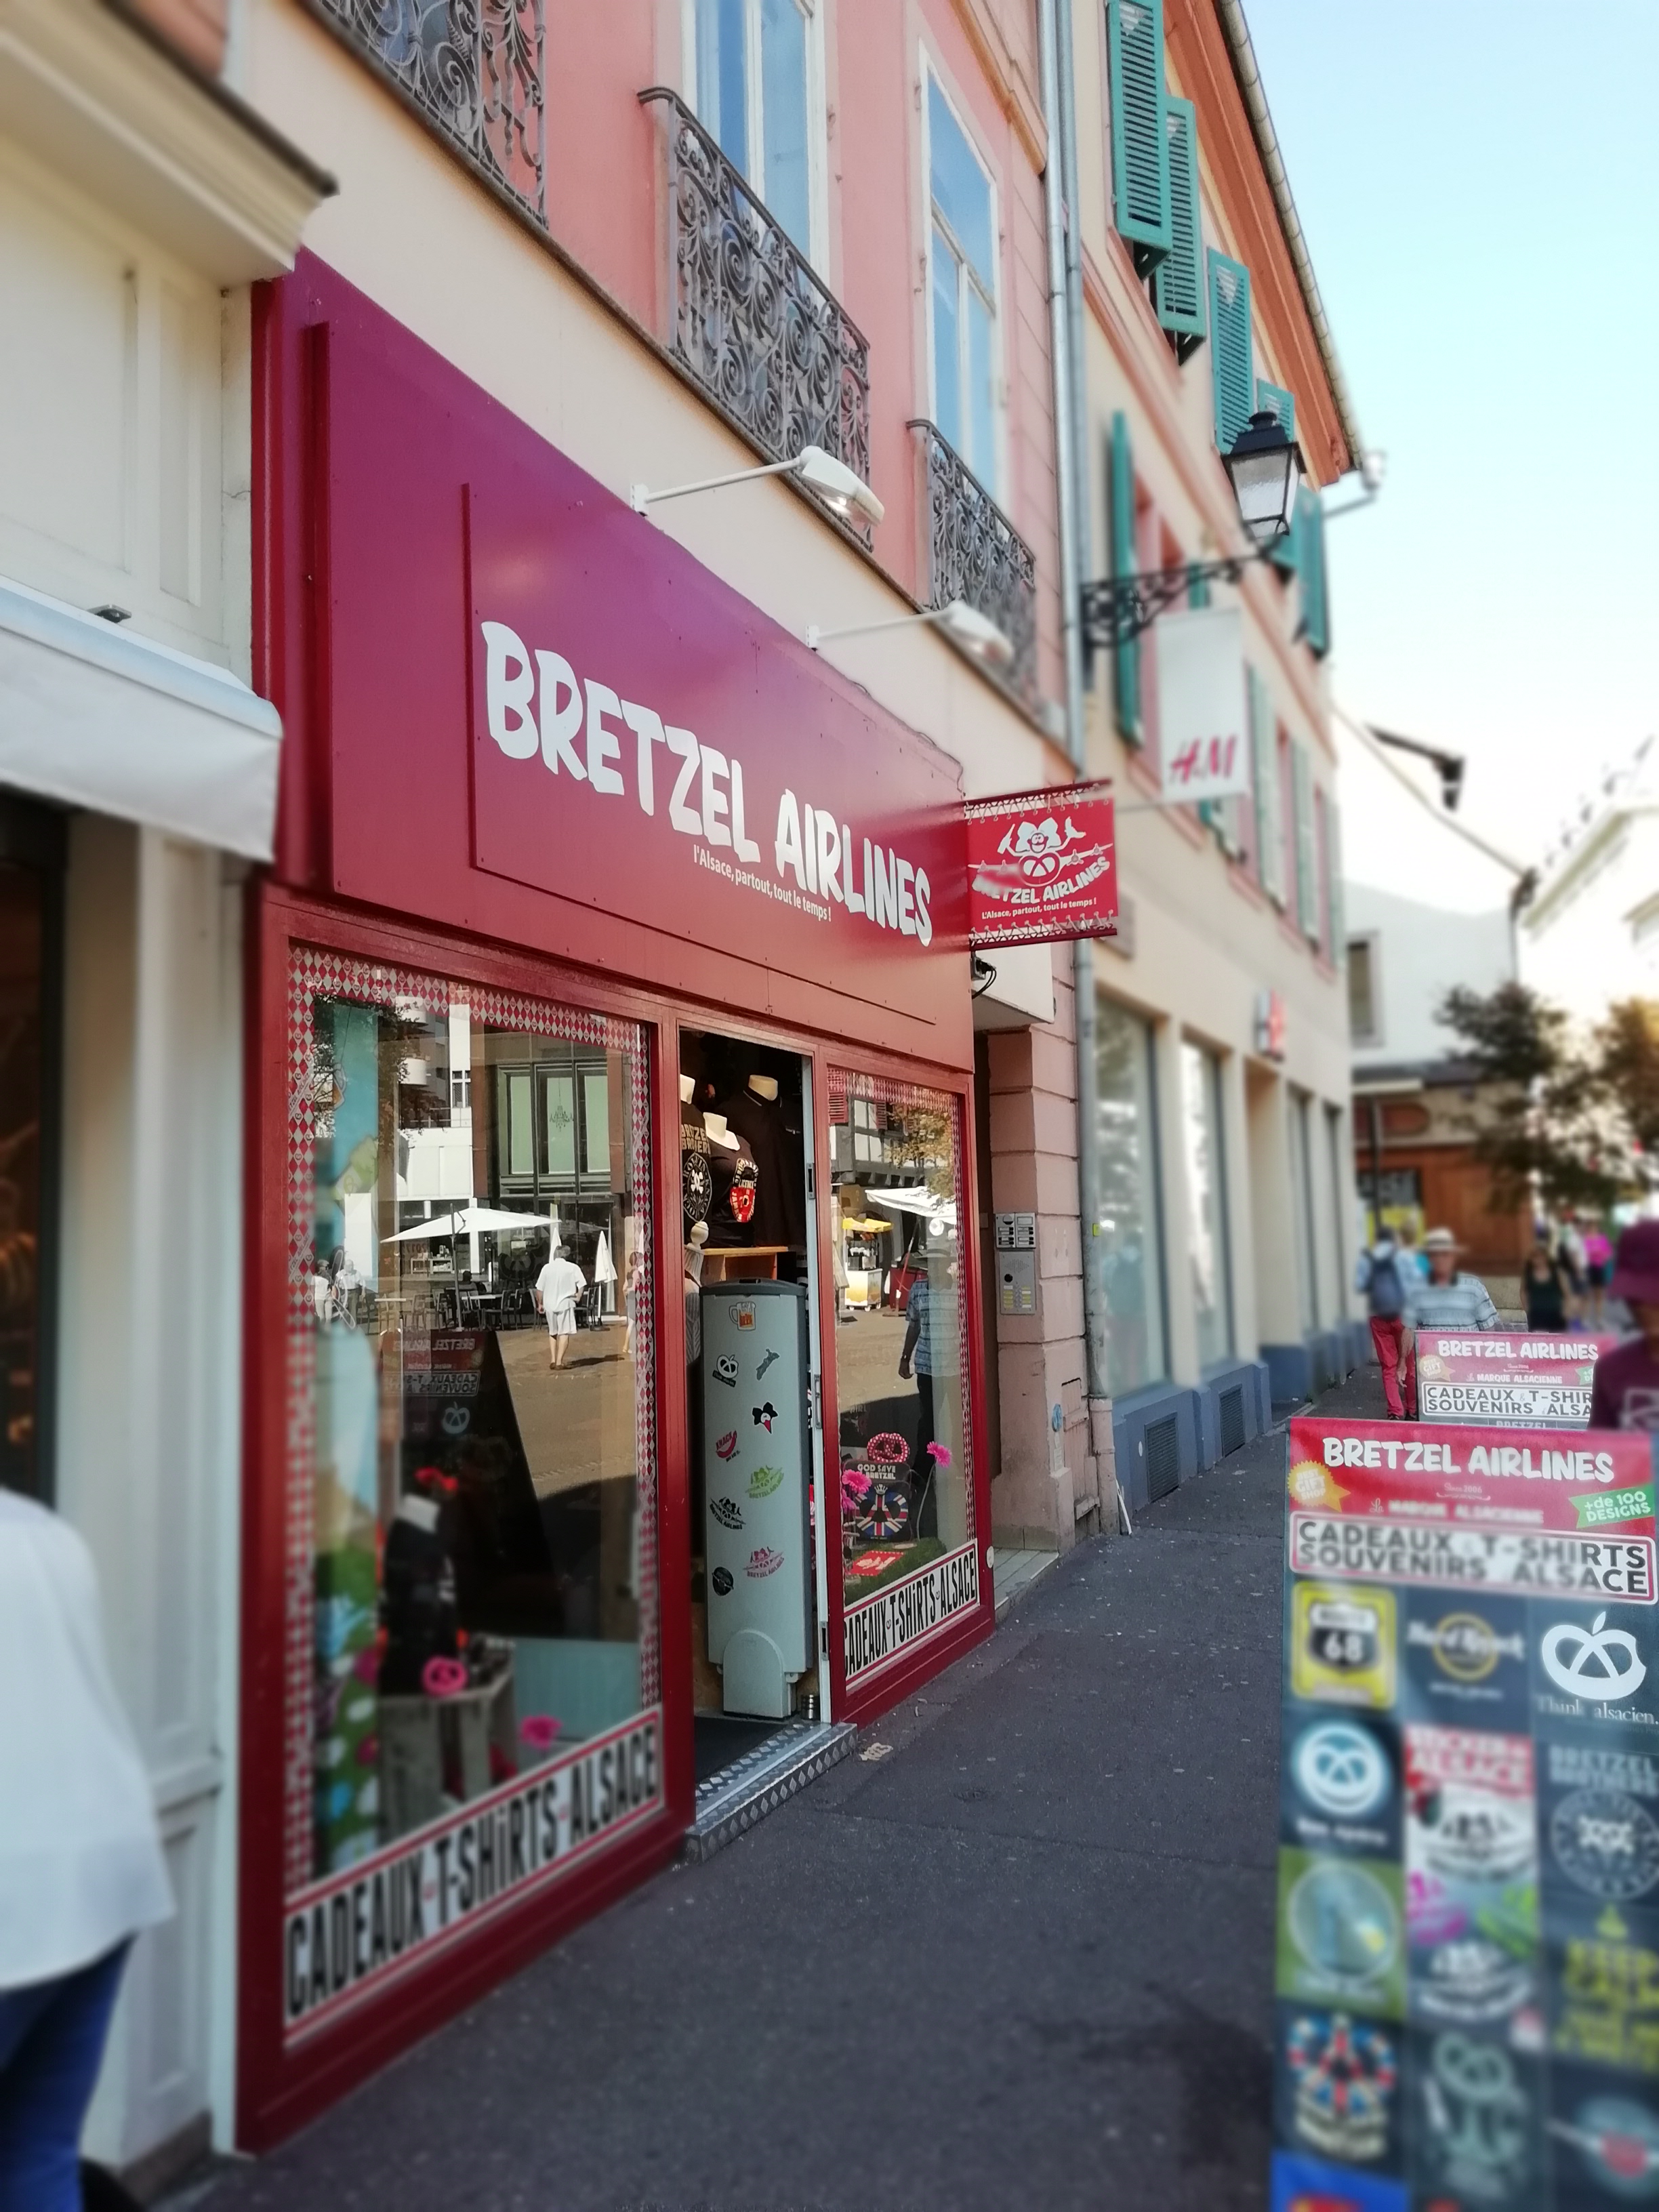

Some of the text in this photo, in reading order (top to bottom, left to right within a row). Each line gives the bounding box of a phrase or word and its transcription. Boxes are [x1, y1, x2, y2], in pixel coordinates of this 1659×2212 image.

[480, 621, 933, 947] BRETZEL AIRLINES
[693, 844, 735, 882] l'Alsace,
[735, 867, 773, 899] partout,
[773, 883, 792, 905] tout
[794, 890, 802, 909] le
[802, 897, 827, 922] temps
[1043, 856, 1110, 901] AIRLINES
[1012, 905, 1042, 917] partout,
[1044, 903, 1059, 912] tout
[1069, 899, 1092, 910] temps
[1437, 1340, 1599, 1361] BRETZEL AIRLINES
[1423, 1361, 1441, 1372] GIFT
[1477, 1373, 1511, 1383] MARQUE
[1513, 1374, 1563, 1385] ALSACIENNE
[1427, 1387, 1515, 1402] CADEAUX
[1427, 1399, 1534, 1414] SOUVENIRS
[857, 1464, 896, 1473] GOD SAVE
[1323, 1437, 1614, 1483] BRETZEL AIRLINES
[1295, 1475, 1326, 1492] GIFT
[1463, 1485, 1483, 1494] 2006
[1617, 1490, 1647, 1505] 100
[1586, 1502, 1651, 1522] DESIGNS
[1299, 1521, 1452, 1552] CADEAUX
[1481, 1534, 1646, 1570] T-SHIRTS
[1299, 1543, 1488, 1580] SOUVENIRS
[1513, 1561, 1648, 1595] ALSACE
[939, 1551, 976, 1618] ALSACE
[1323, 1632, 1364, 1662] 68
[1594, 1702, 1659, 1725] alsacien.
[287, 1851, 426, 2017] CADEAUX
[571, 1723, 656, 1845] ALSACE
